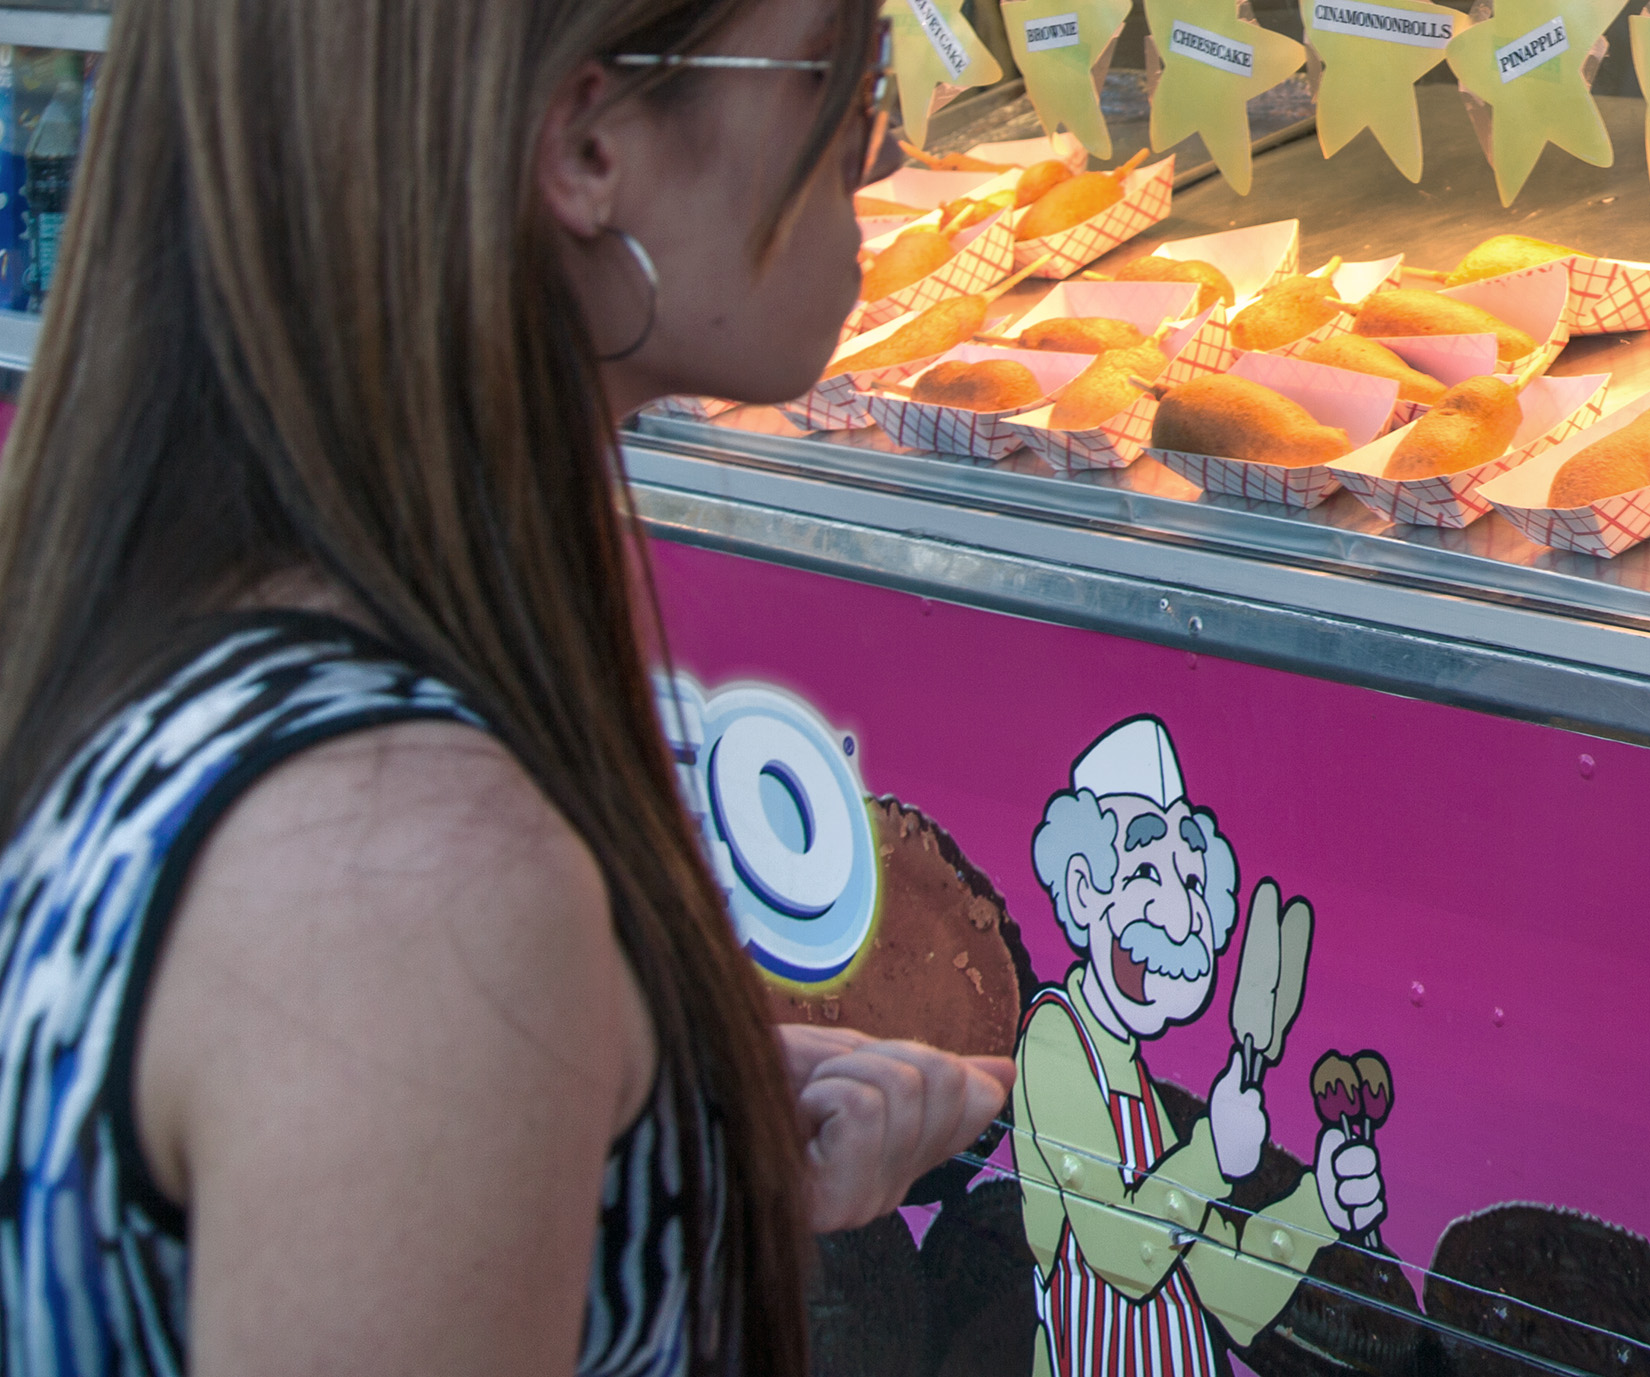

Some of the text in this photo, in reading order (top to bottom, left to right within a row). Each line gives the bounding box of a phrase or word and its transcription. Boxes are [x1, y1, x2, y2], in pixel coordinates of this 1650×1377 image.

[1026, 21, 1078, 44] BROWNIE
[1314, 4, 1453, 40] CINAMONNONROLLS
[1172, 28, 1252, 68] CHEESECAKE
[1499, 25, 1566, 74] PINAPPLE
